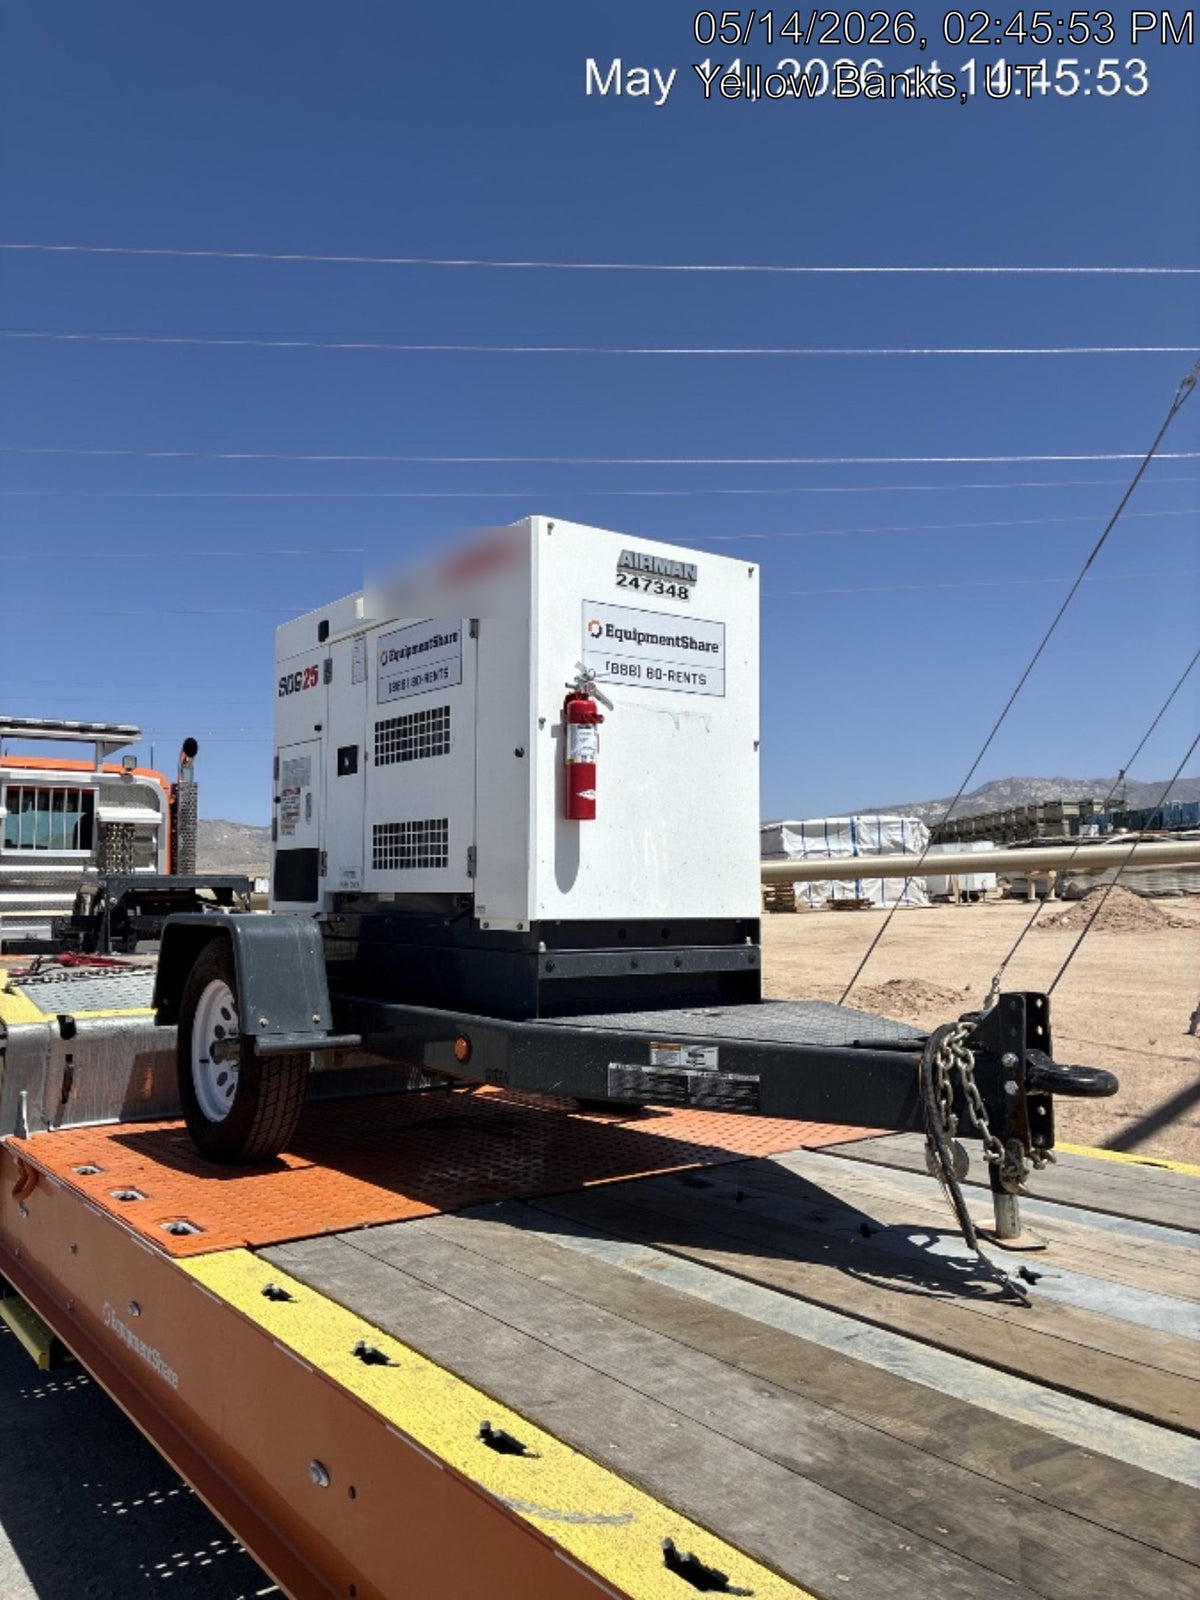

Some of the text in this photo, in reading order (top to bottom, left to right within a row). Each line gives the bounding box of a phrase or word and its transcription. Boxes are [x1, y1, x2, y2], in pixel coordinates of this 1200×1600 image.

[617, 549, 698, 582] AIRMAN
[616, 573, 689, 600] 247348
[389, 632, 458, 662] EquipmentShare
[605, 623, 719, 654] EquipmentShare
